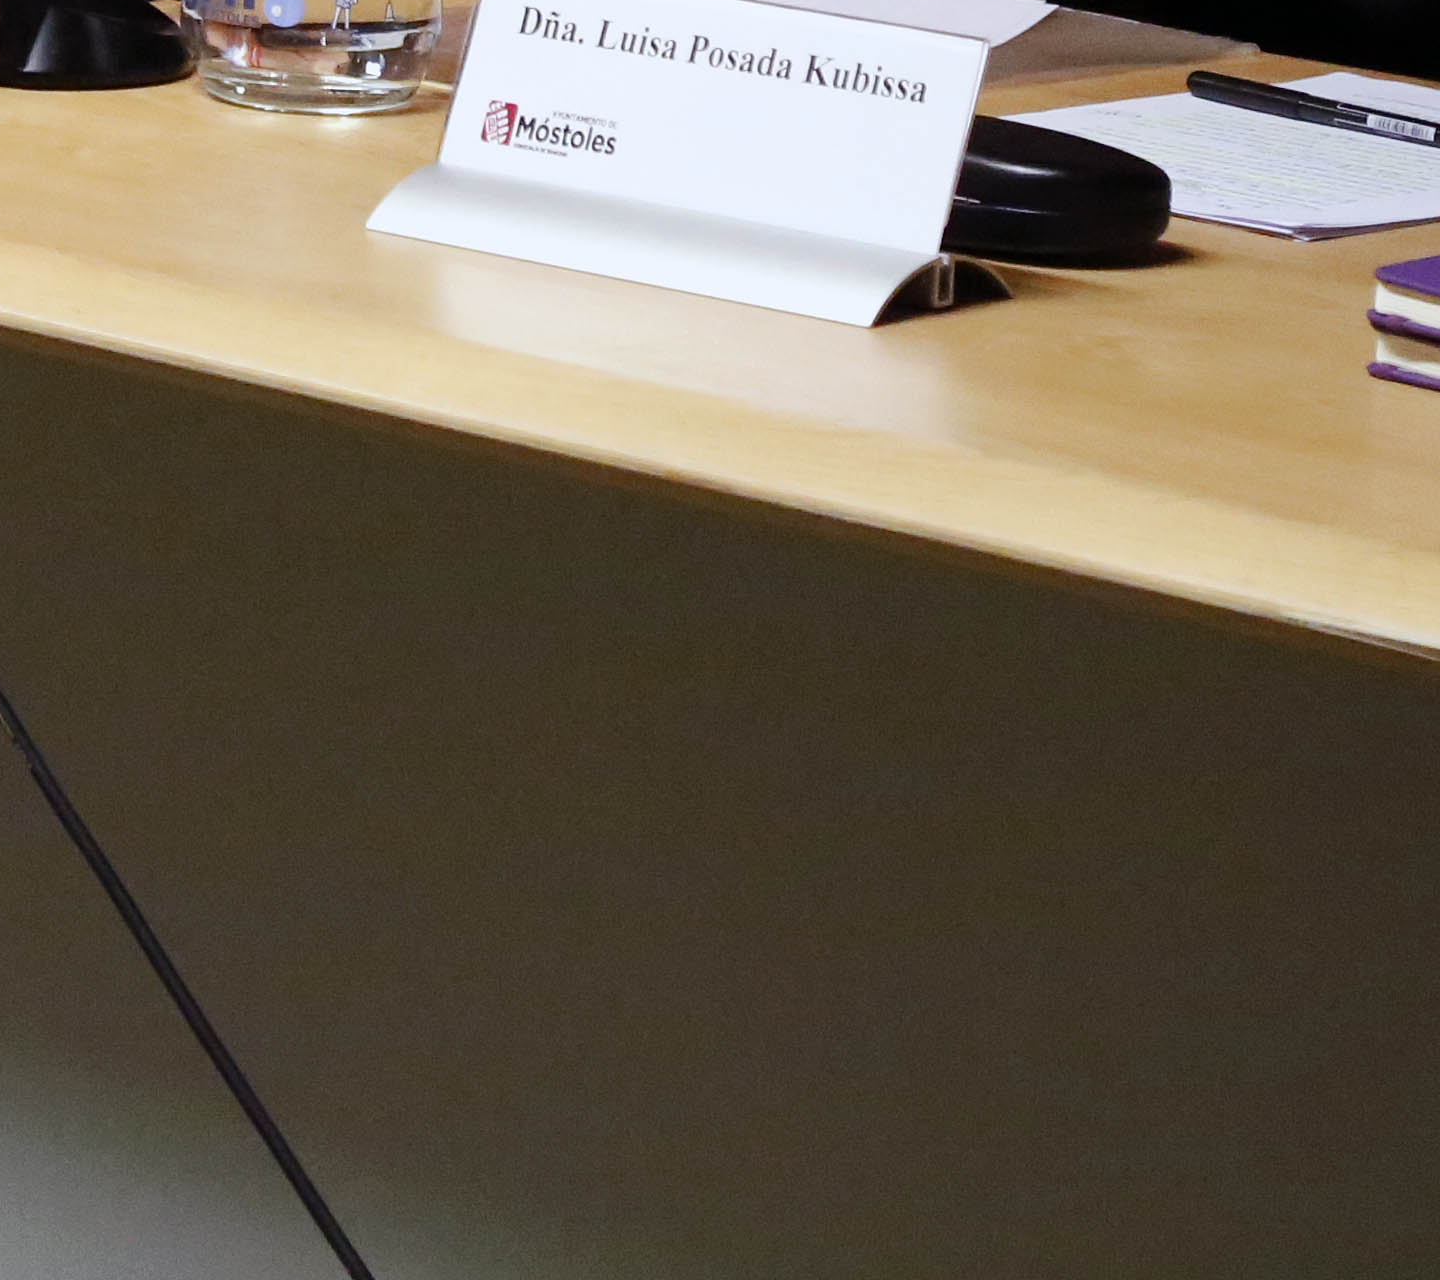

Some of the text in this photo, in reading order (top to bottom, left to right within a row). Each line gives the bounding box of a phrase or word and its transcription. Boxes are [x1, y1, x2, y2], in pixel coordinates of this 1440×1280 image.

[518, 5, 928, 104] Dña. Luisa Posada Kubissa
[515, 115, 617, 155] Móstoles
